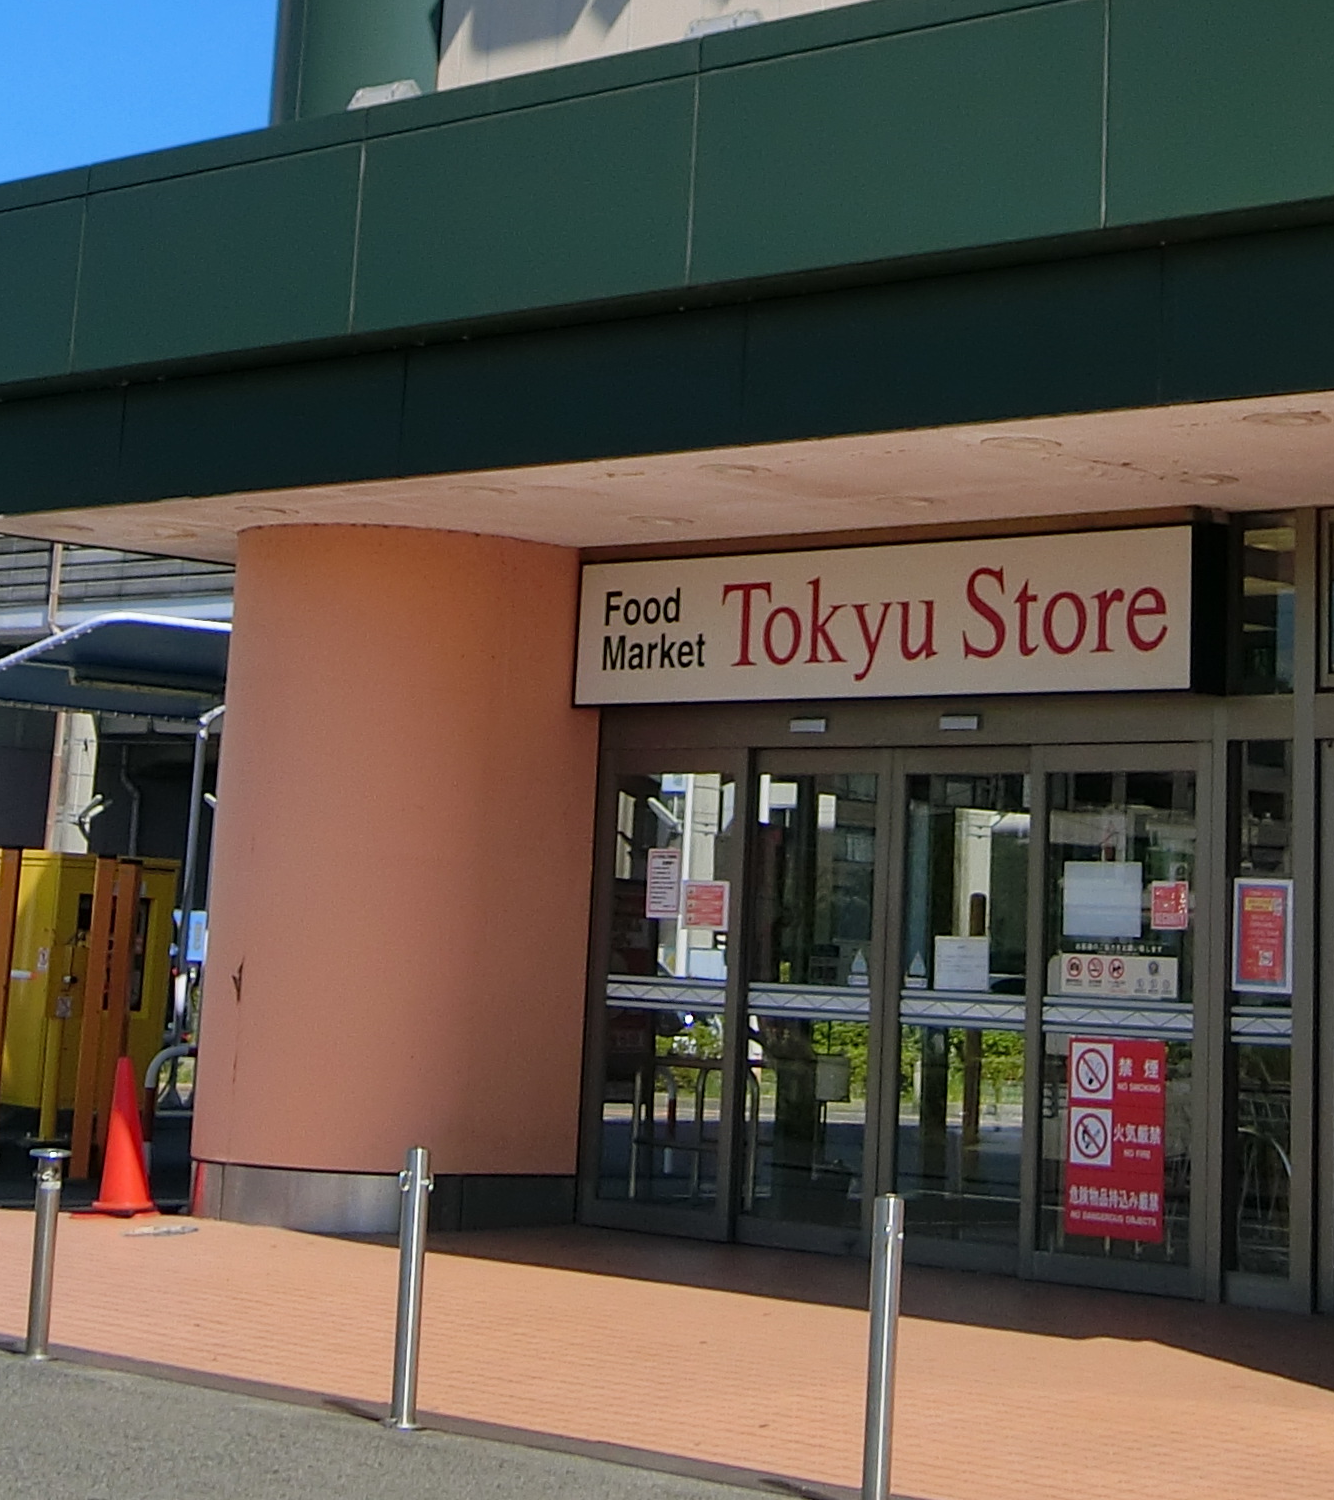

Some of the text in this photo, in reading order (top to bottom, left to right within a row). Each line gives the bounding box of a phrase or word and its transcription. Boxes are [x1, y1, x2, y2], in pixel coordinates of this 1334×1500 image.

[603, 586, 682, 628] Food
[722, 565, 1169, 682] Tokyu Store
[601, 632, 706, 672] Market
[1118, 1056, 1160, 1079] 禁煙
[1117, 1082, 1161, 1094] NO SMOKING
[1113, 1123, 1162, 1146] 火気厳禁
[1123, 1148, 1151, 1160] NO FIRE
[1069, 1209, 1081, 1220] NO
